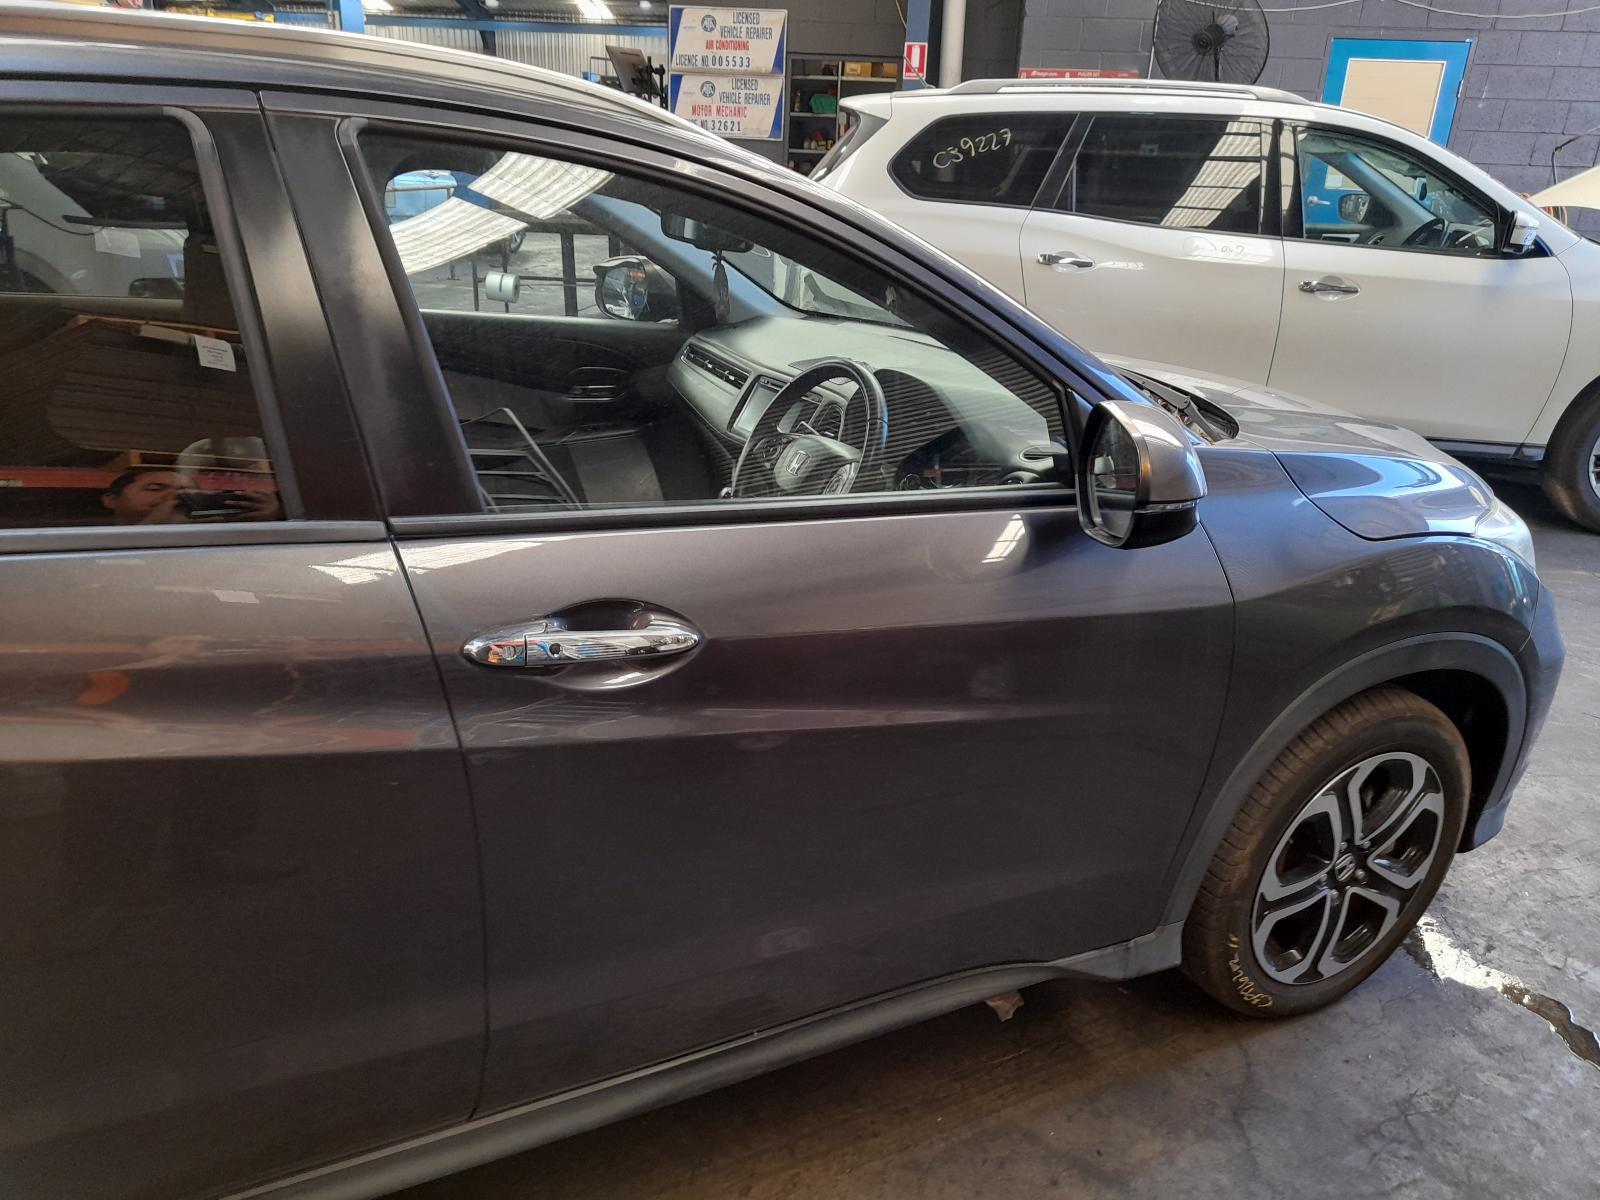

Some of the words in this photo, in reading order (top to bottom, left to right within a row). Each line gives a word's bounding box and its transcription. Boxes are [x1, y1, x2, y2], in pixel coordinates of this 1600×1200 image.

[733, 11, 760, 25] LICENSED
[720, 26, 743, 39] VEHICLE
[746, 27, 773, 40] REPAIRER
[706, 40, 714, 50] AIR
[716, 40, 749, 51] CONDITIONING
[676, 54, 698, 66] LICENCE
[711, 55, 751, 68] 005533
[731, 78, 758, 91] LICENSED
[719, 91, 742, 104] VEHICLE
[744, 93, 771, 105] REPAIRER
[691, 104, 712, 117] MOTOR
[716, 105, 748, 118] MECHANIC
[711, 119, 741, 132] 32621
[932, 127, 1012, 169] C39227
